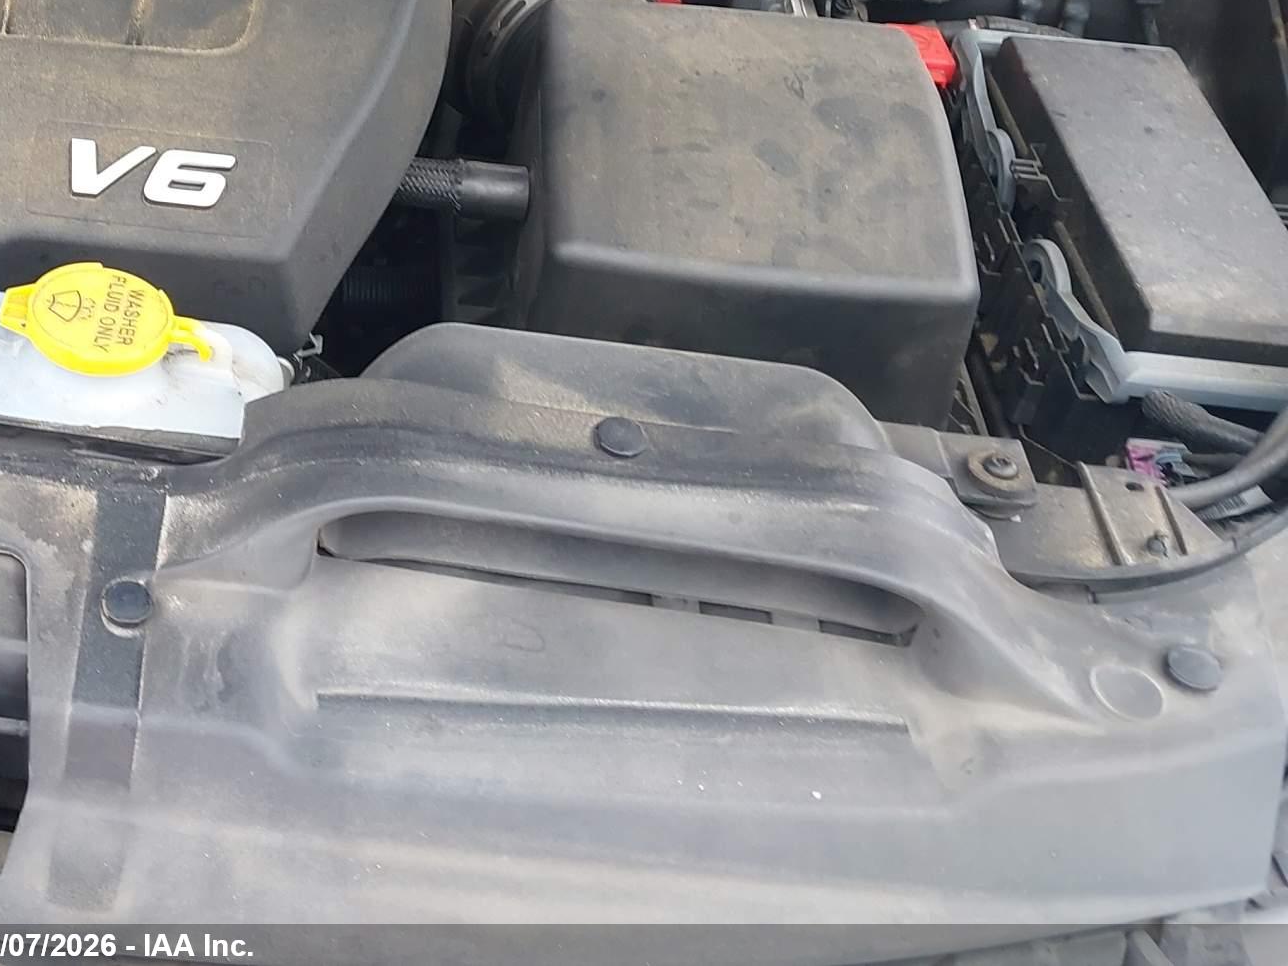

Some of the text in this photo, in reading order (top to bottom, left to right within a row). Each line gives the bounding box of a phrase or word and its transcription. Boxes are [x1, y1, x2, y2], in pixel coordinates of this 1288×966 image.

[70, 138, 237, 209] V6
[92, 274, 128, 354] FLUID ONLY
[115, 288, 146, 346] WASHER
